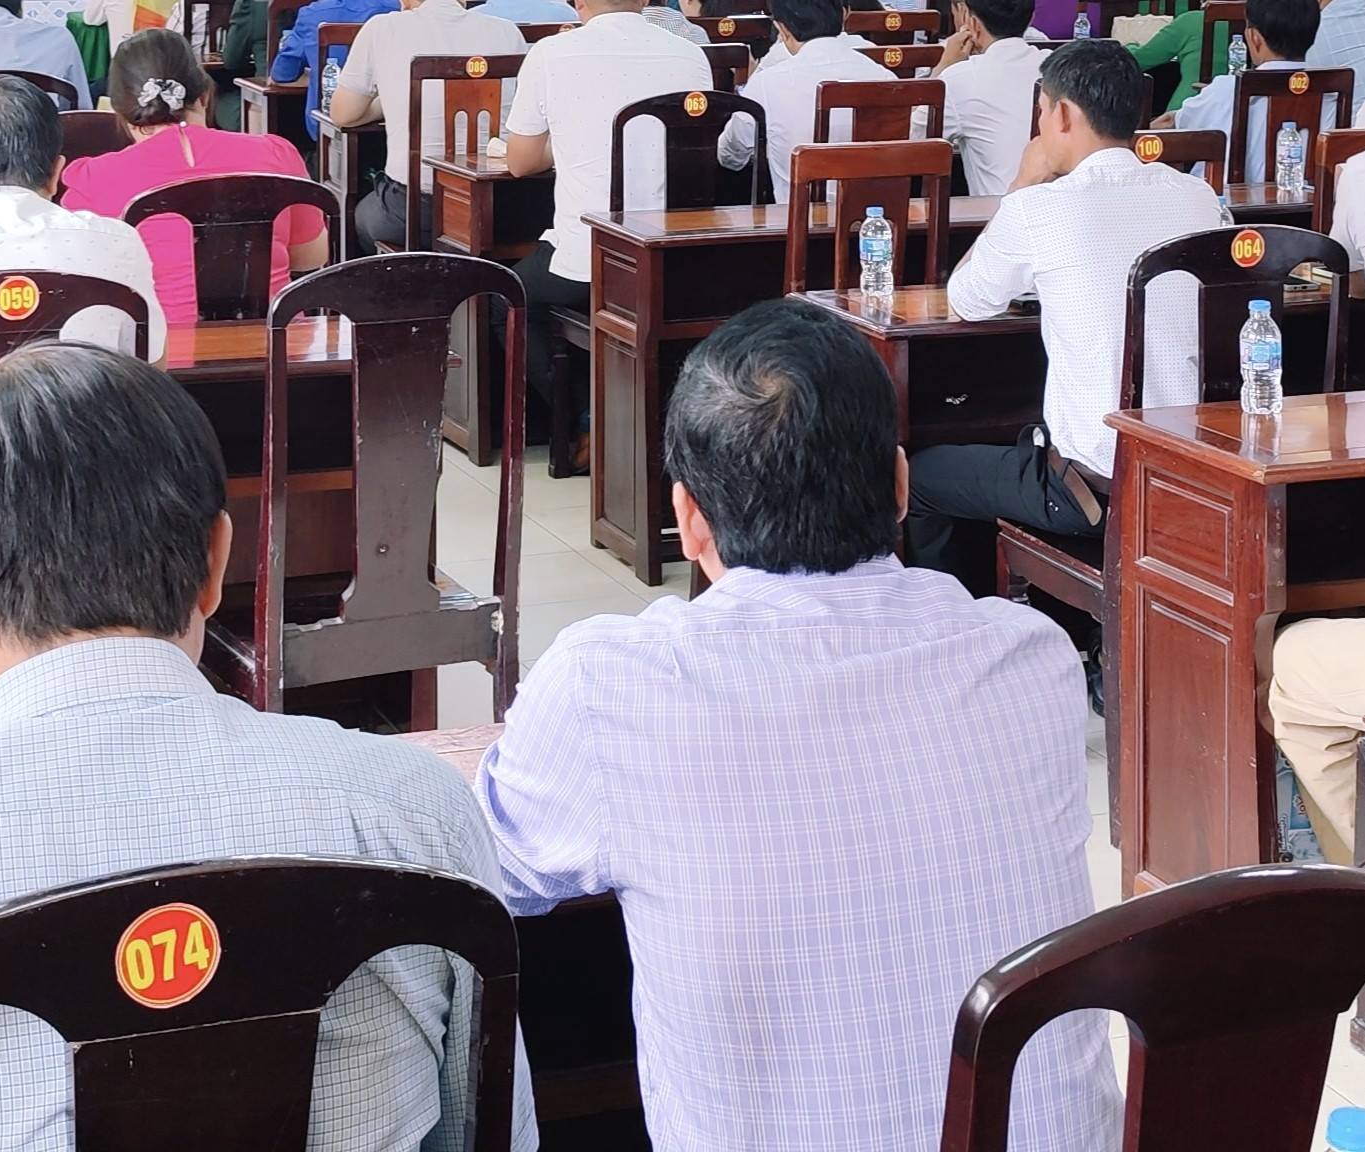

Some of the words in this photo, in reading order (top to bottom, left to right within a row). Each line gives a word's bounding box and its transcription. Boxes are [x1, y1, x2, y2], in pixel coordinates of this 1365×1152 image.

[469, 60, 485, 74] 086
[1291, 76, 1307, 90] 002
[687, 97, 706, 111] 063
[1138, 140, 1161, 158] 100
[1234, 239, 1262, 259] 064
[0, 288, 35, 313] 059
[124, 922, 211, 992] 074
